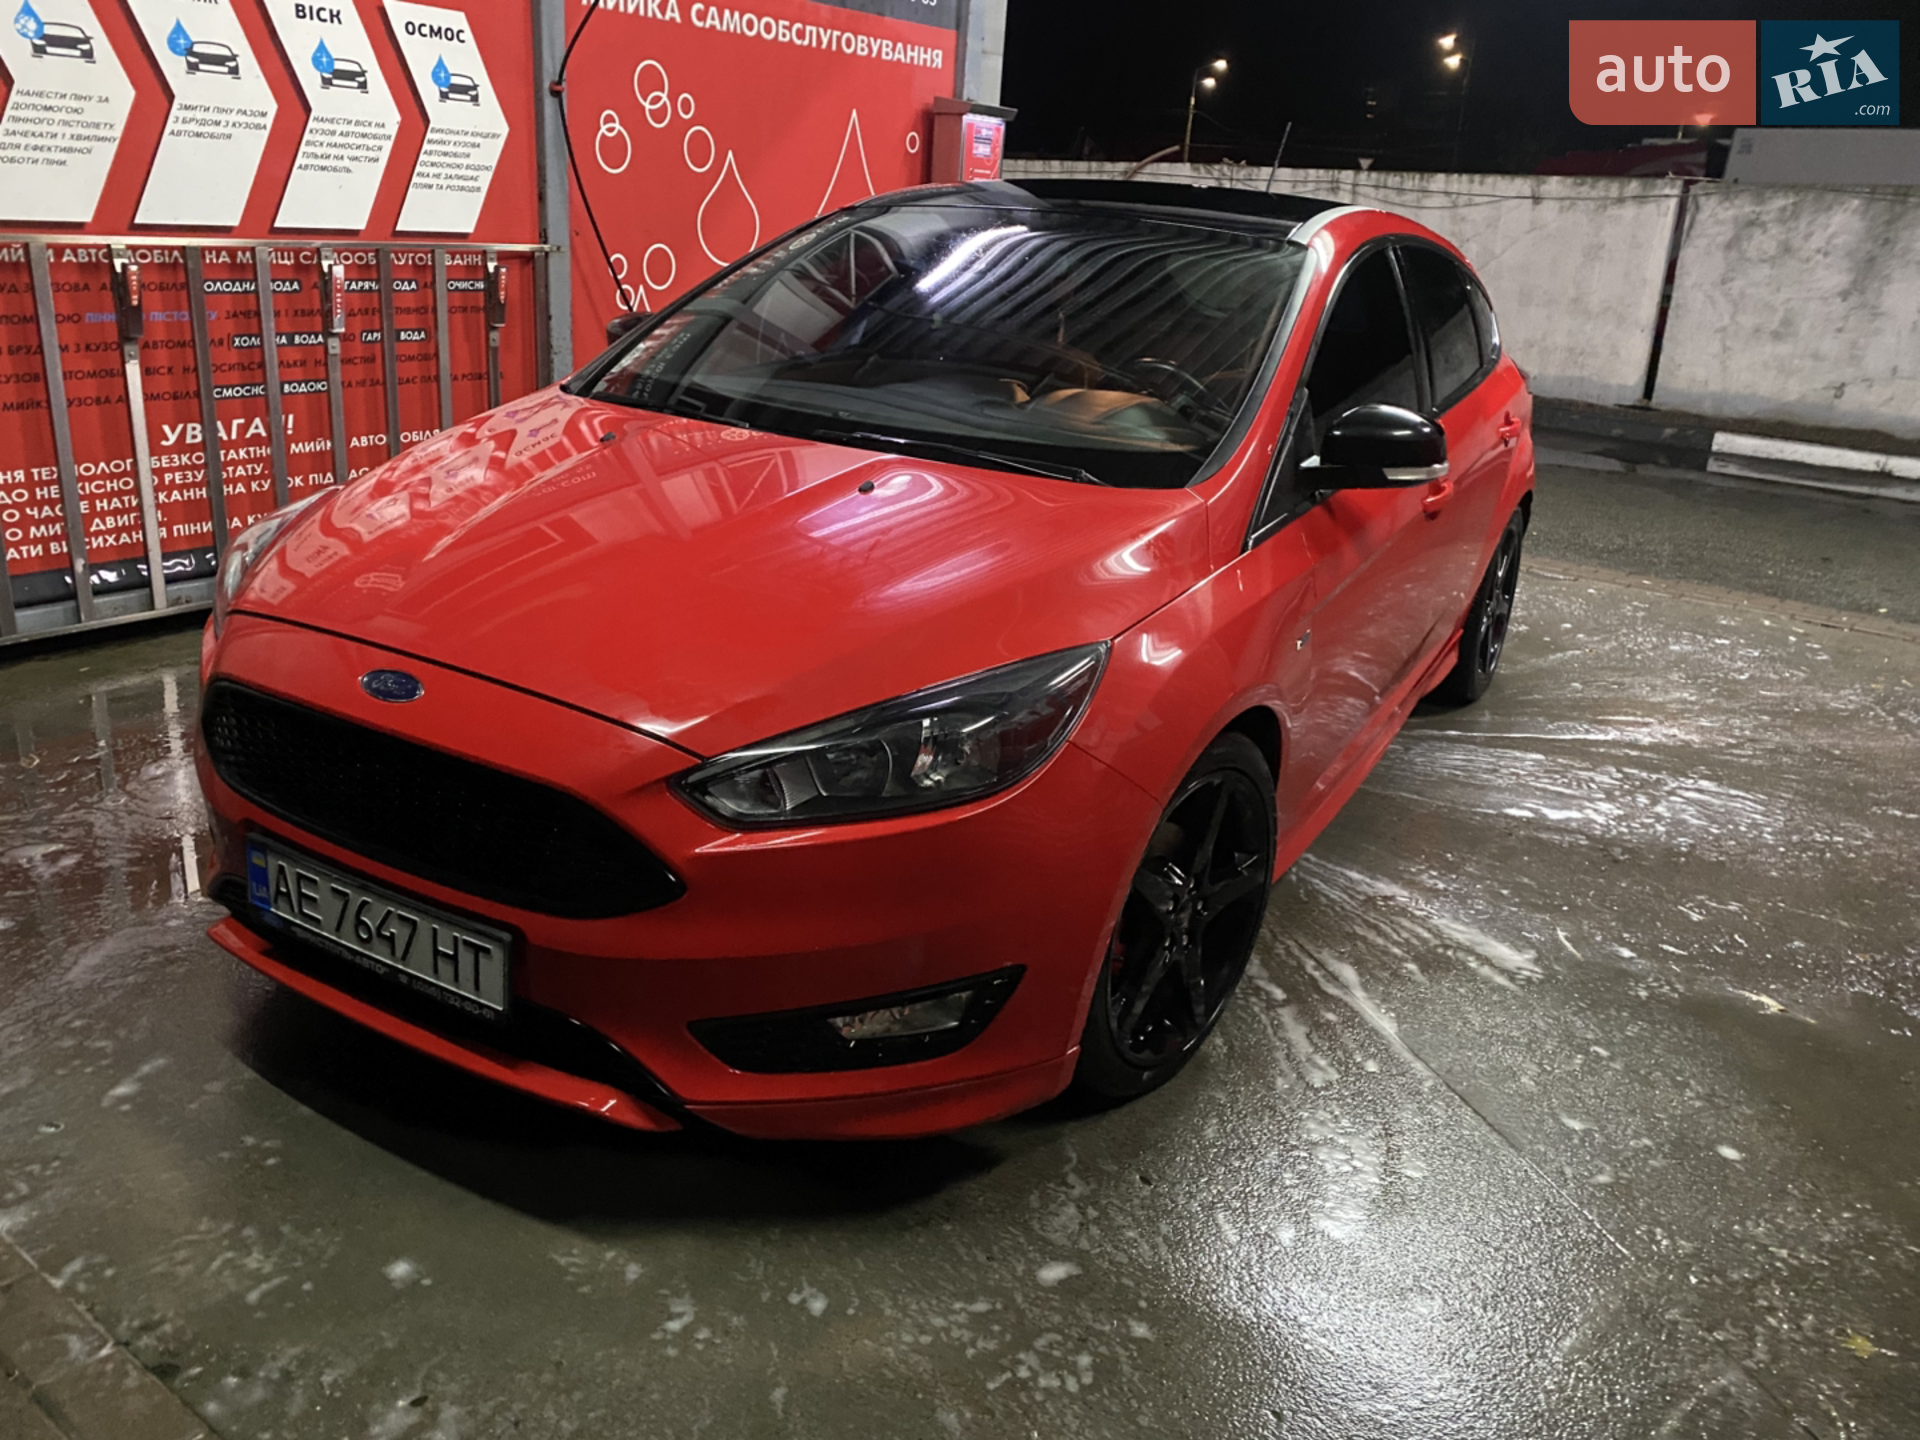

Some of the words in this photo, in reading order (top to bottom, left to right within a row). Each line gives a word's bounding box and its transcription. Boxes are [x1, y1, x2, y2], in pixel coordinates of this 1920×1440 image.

[295, 3, 342, 24] ВІСК
[404, 21, 465, 43] ОСМОС
[690, 3, 943, 69] САМООБСЛУГОВУВАННЯ
[15, 89, 67, 100] НАНЕСТИ
[10, 101, 84, 115] ДОПОМОГОЮ
[177, 103, 211, 113] ЗМИТИ
[236, 108, 269, 118] РАЗОМ
[2, 128, 58, 140] ЗАЧЕКАТИ
[168, 129, 233, 141] АВТОМОБІЛЯ
[61, 248, 184, 264] АВТООБІЛ
[204, 250, 231, 264] НА
[294, 334, 324, 345] ВОДА
[213, 385, 266, 398] СМОСНО
[283, 381, 327, 393] ВОДОЮ
[290, 438, 332, 455] МИЙК
[350, 429, 441, 449] АВТООБІЛЯ
[331, 883, 419, 962] 7647
